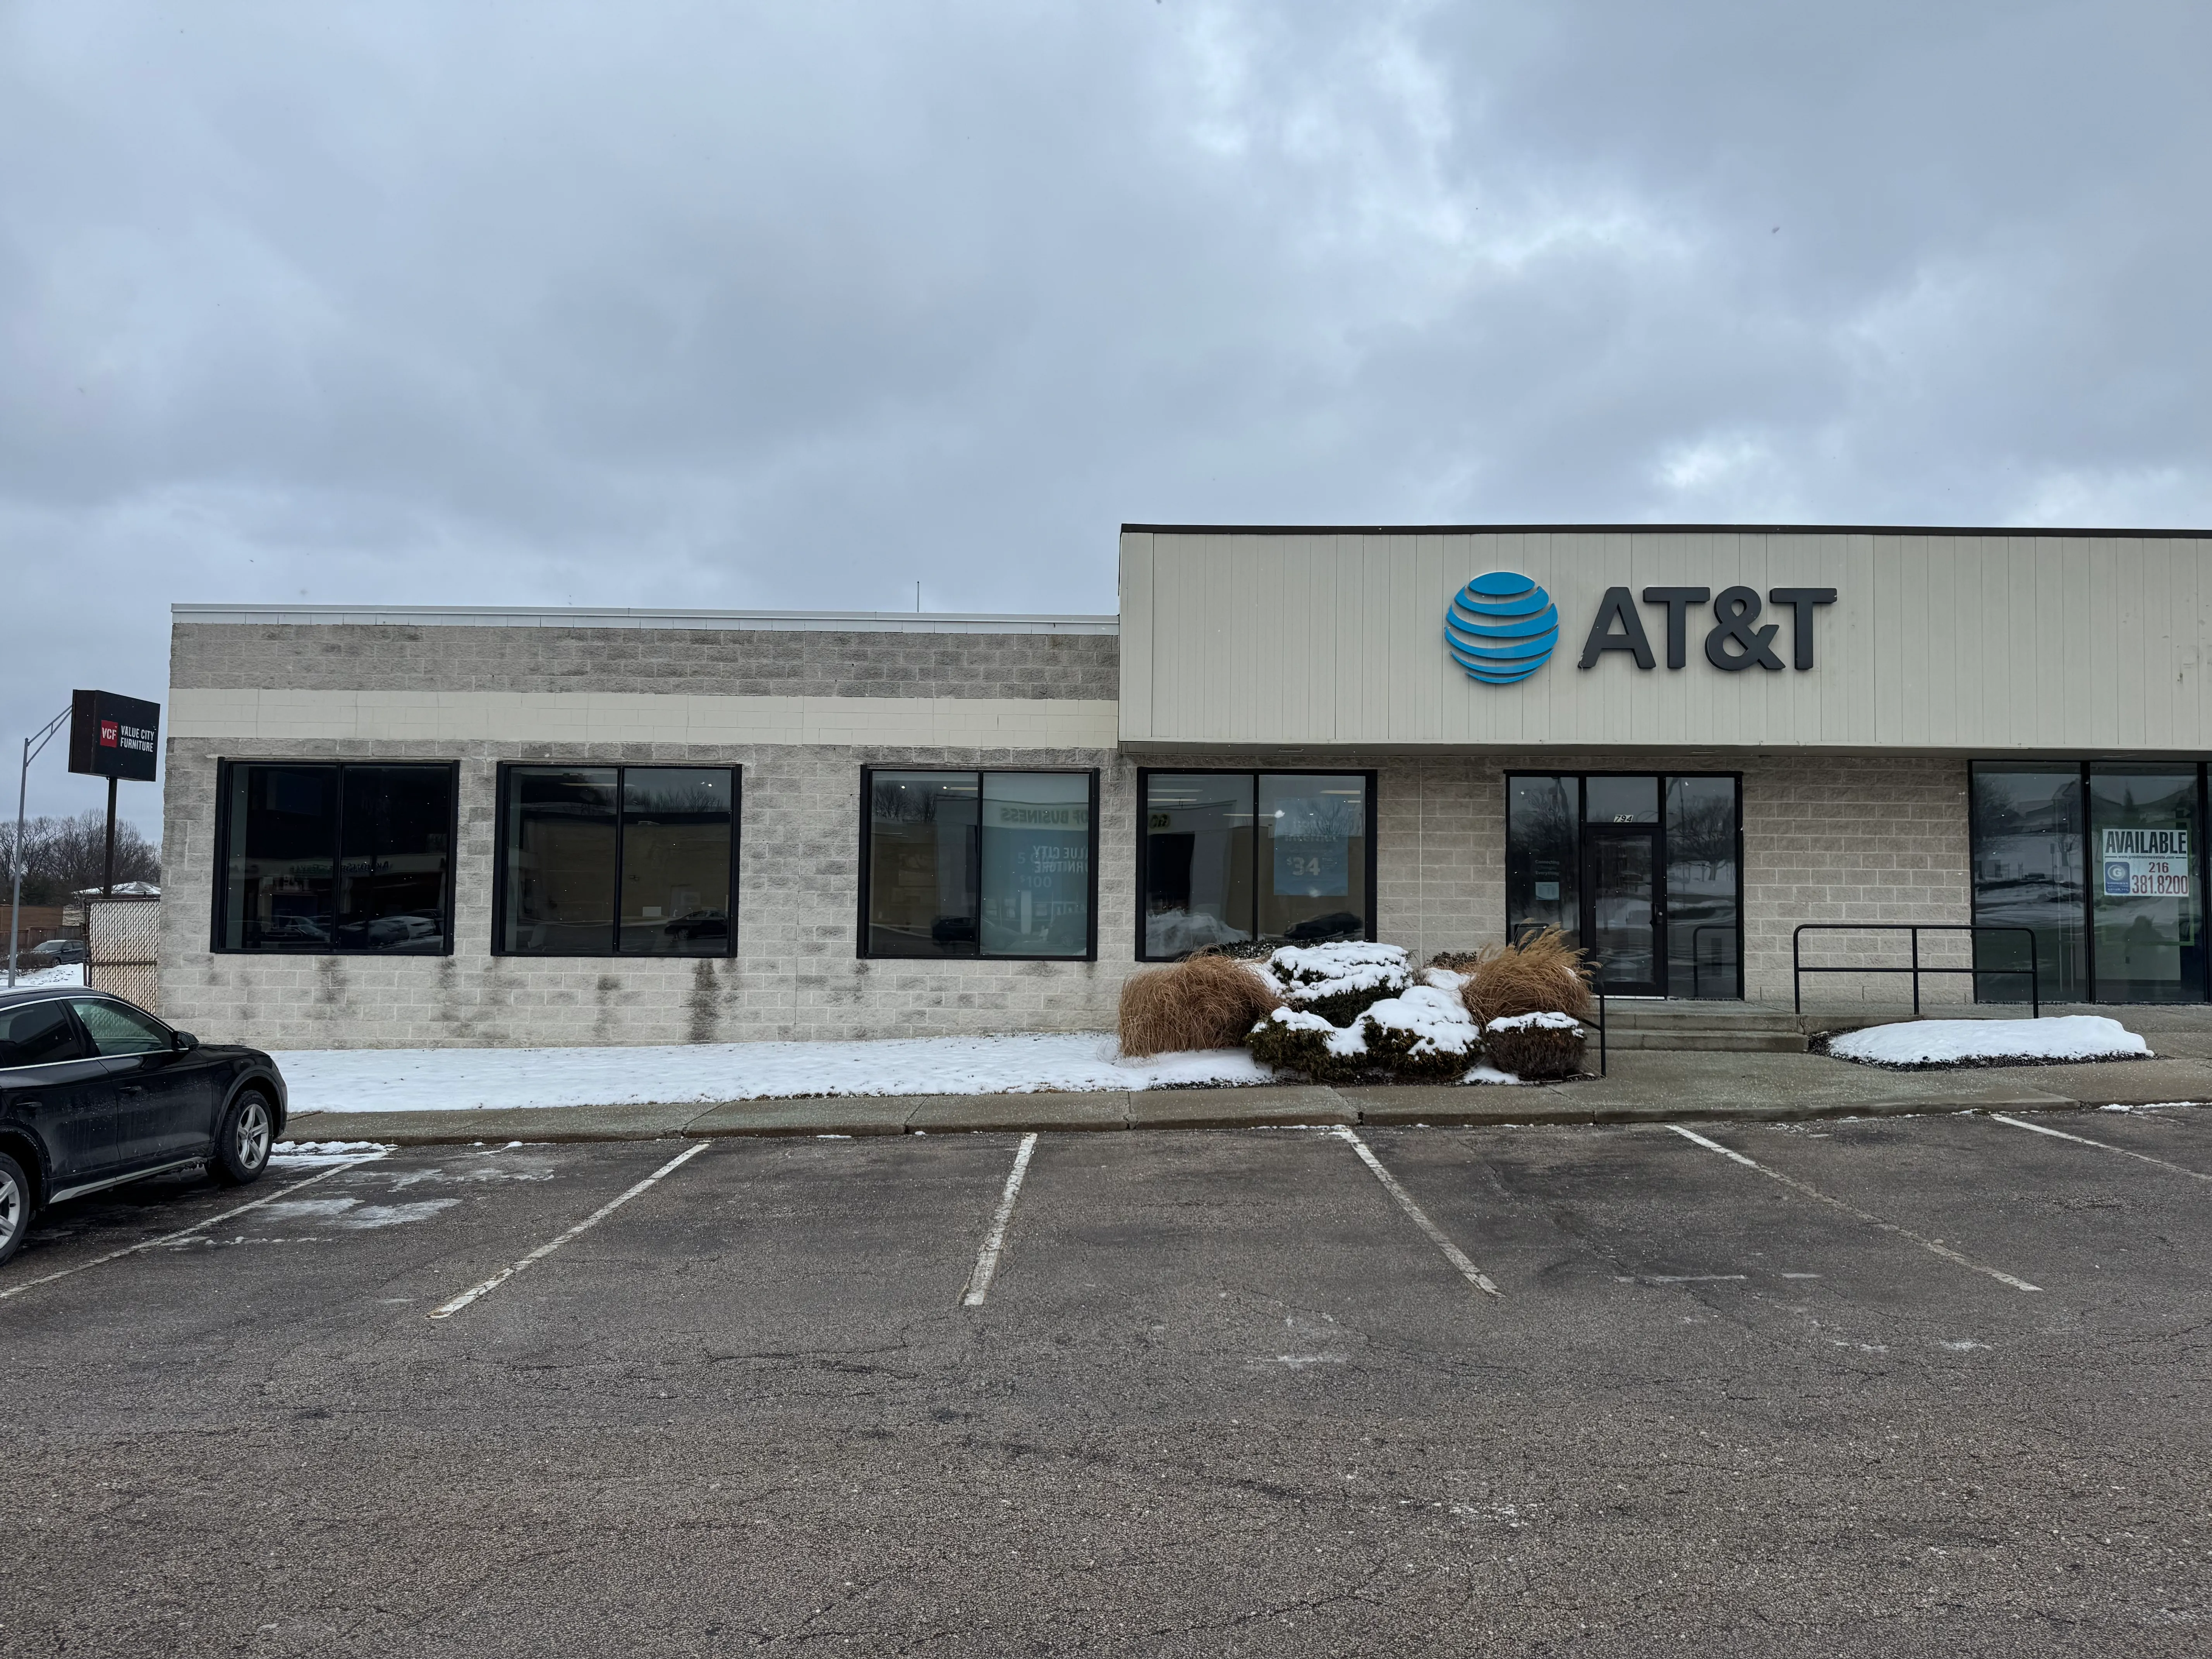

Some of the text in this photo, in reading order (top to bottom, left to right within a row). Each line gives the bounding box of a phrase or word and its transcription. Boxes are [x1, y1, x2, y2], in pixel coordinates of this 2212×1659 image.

[1577, 586, 1837, 670] AT&T
[102, 727, 117, 740] VCF
[121, 725, 155, 741] VALUE CITY
[120, 737, 153, 752] FURNITURE
[2105, 831, 2186, 854] AVAILABLE
[1018, 852, 1025, 864] 5
[1286, 856, 1321, 876] $34
[2149, 862, 2169, 873] 216
[1019, 874, 1052, 888] $100
[2131, 875, 2188, 894] 381.8200
